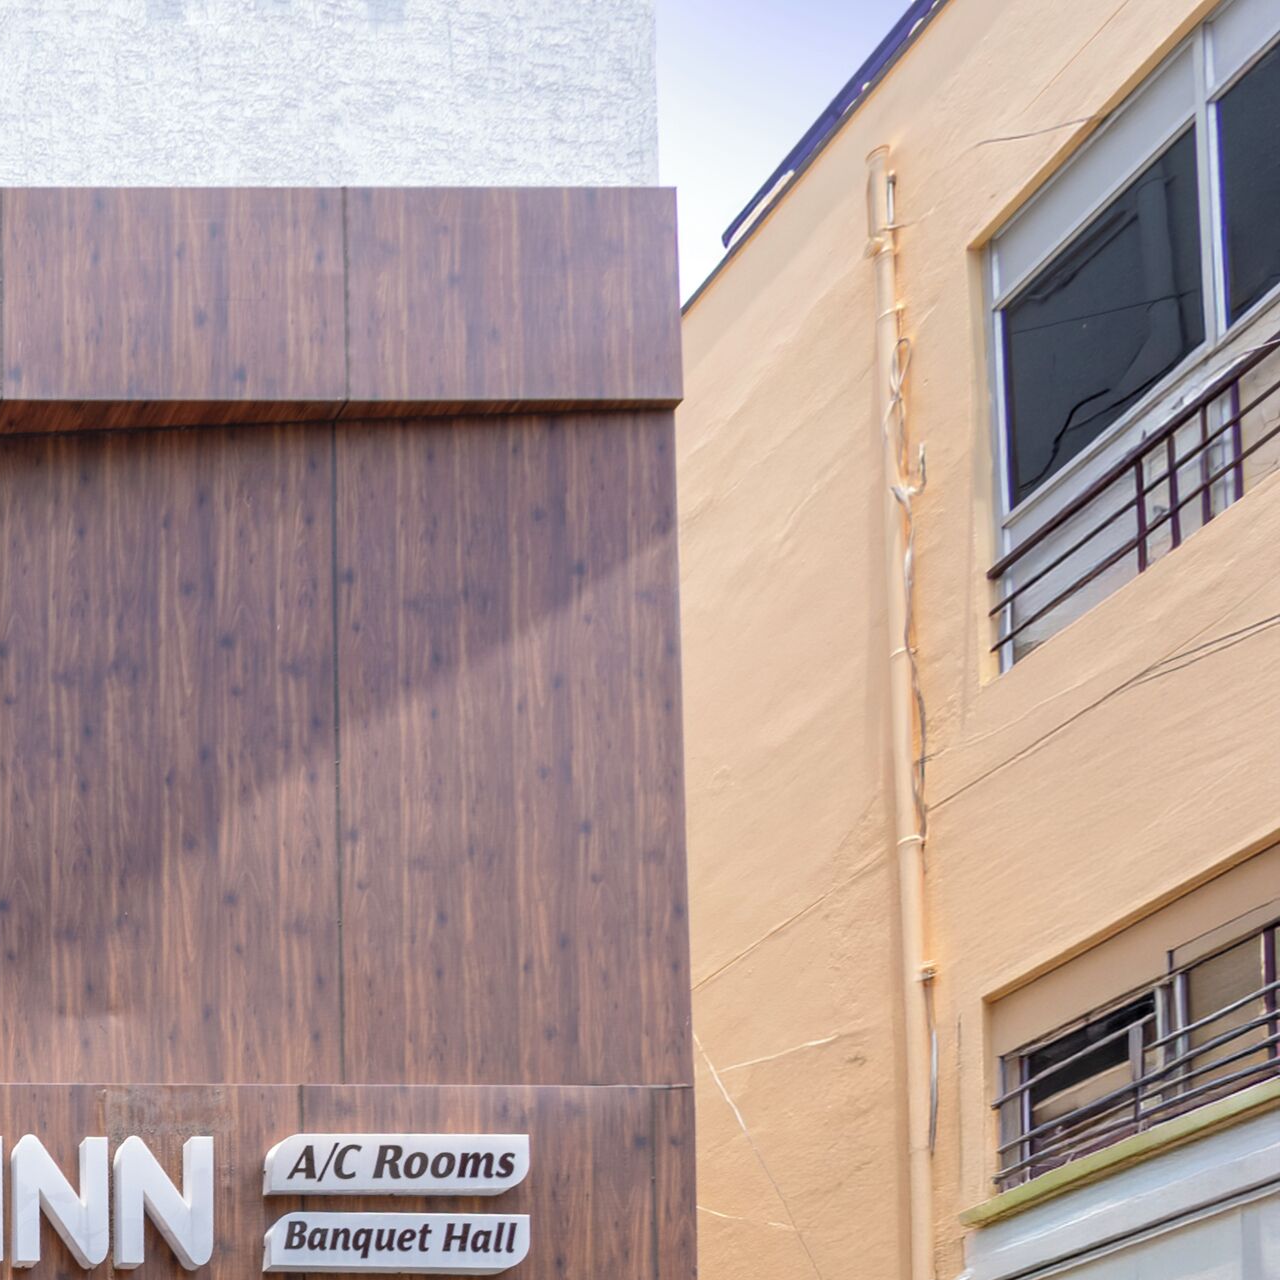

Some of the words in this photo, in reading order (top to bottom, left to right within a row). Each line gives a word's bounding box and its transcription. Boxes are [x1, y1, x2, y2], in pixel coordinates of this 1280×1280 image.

[287, 1142, 362, 1182] A/C
[373, 1144, 516, 1179] Rooms
[284, 1220, 433, 1259] Banquet
[442, 1222, 517, 1253] Hall
